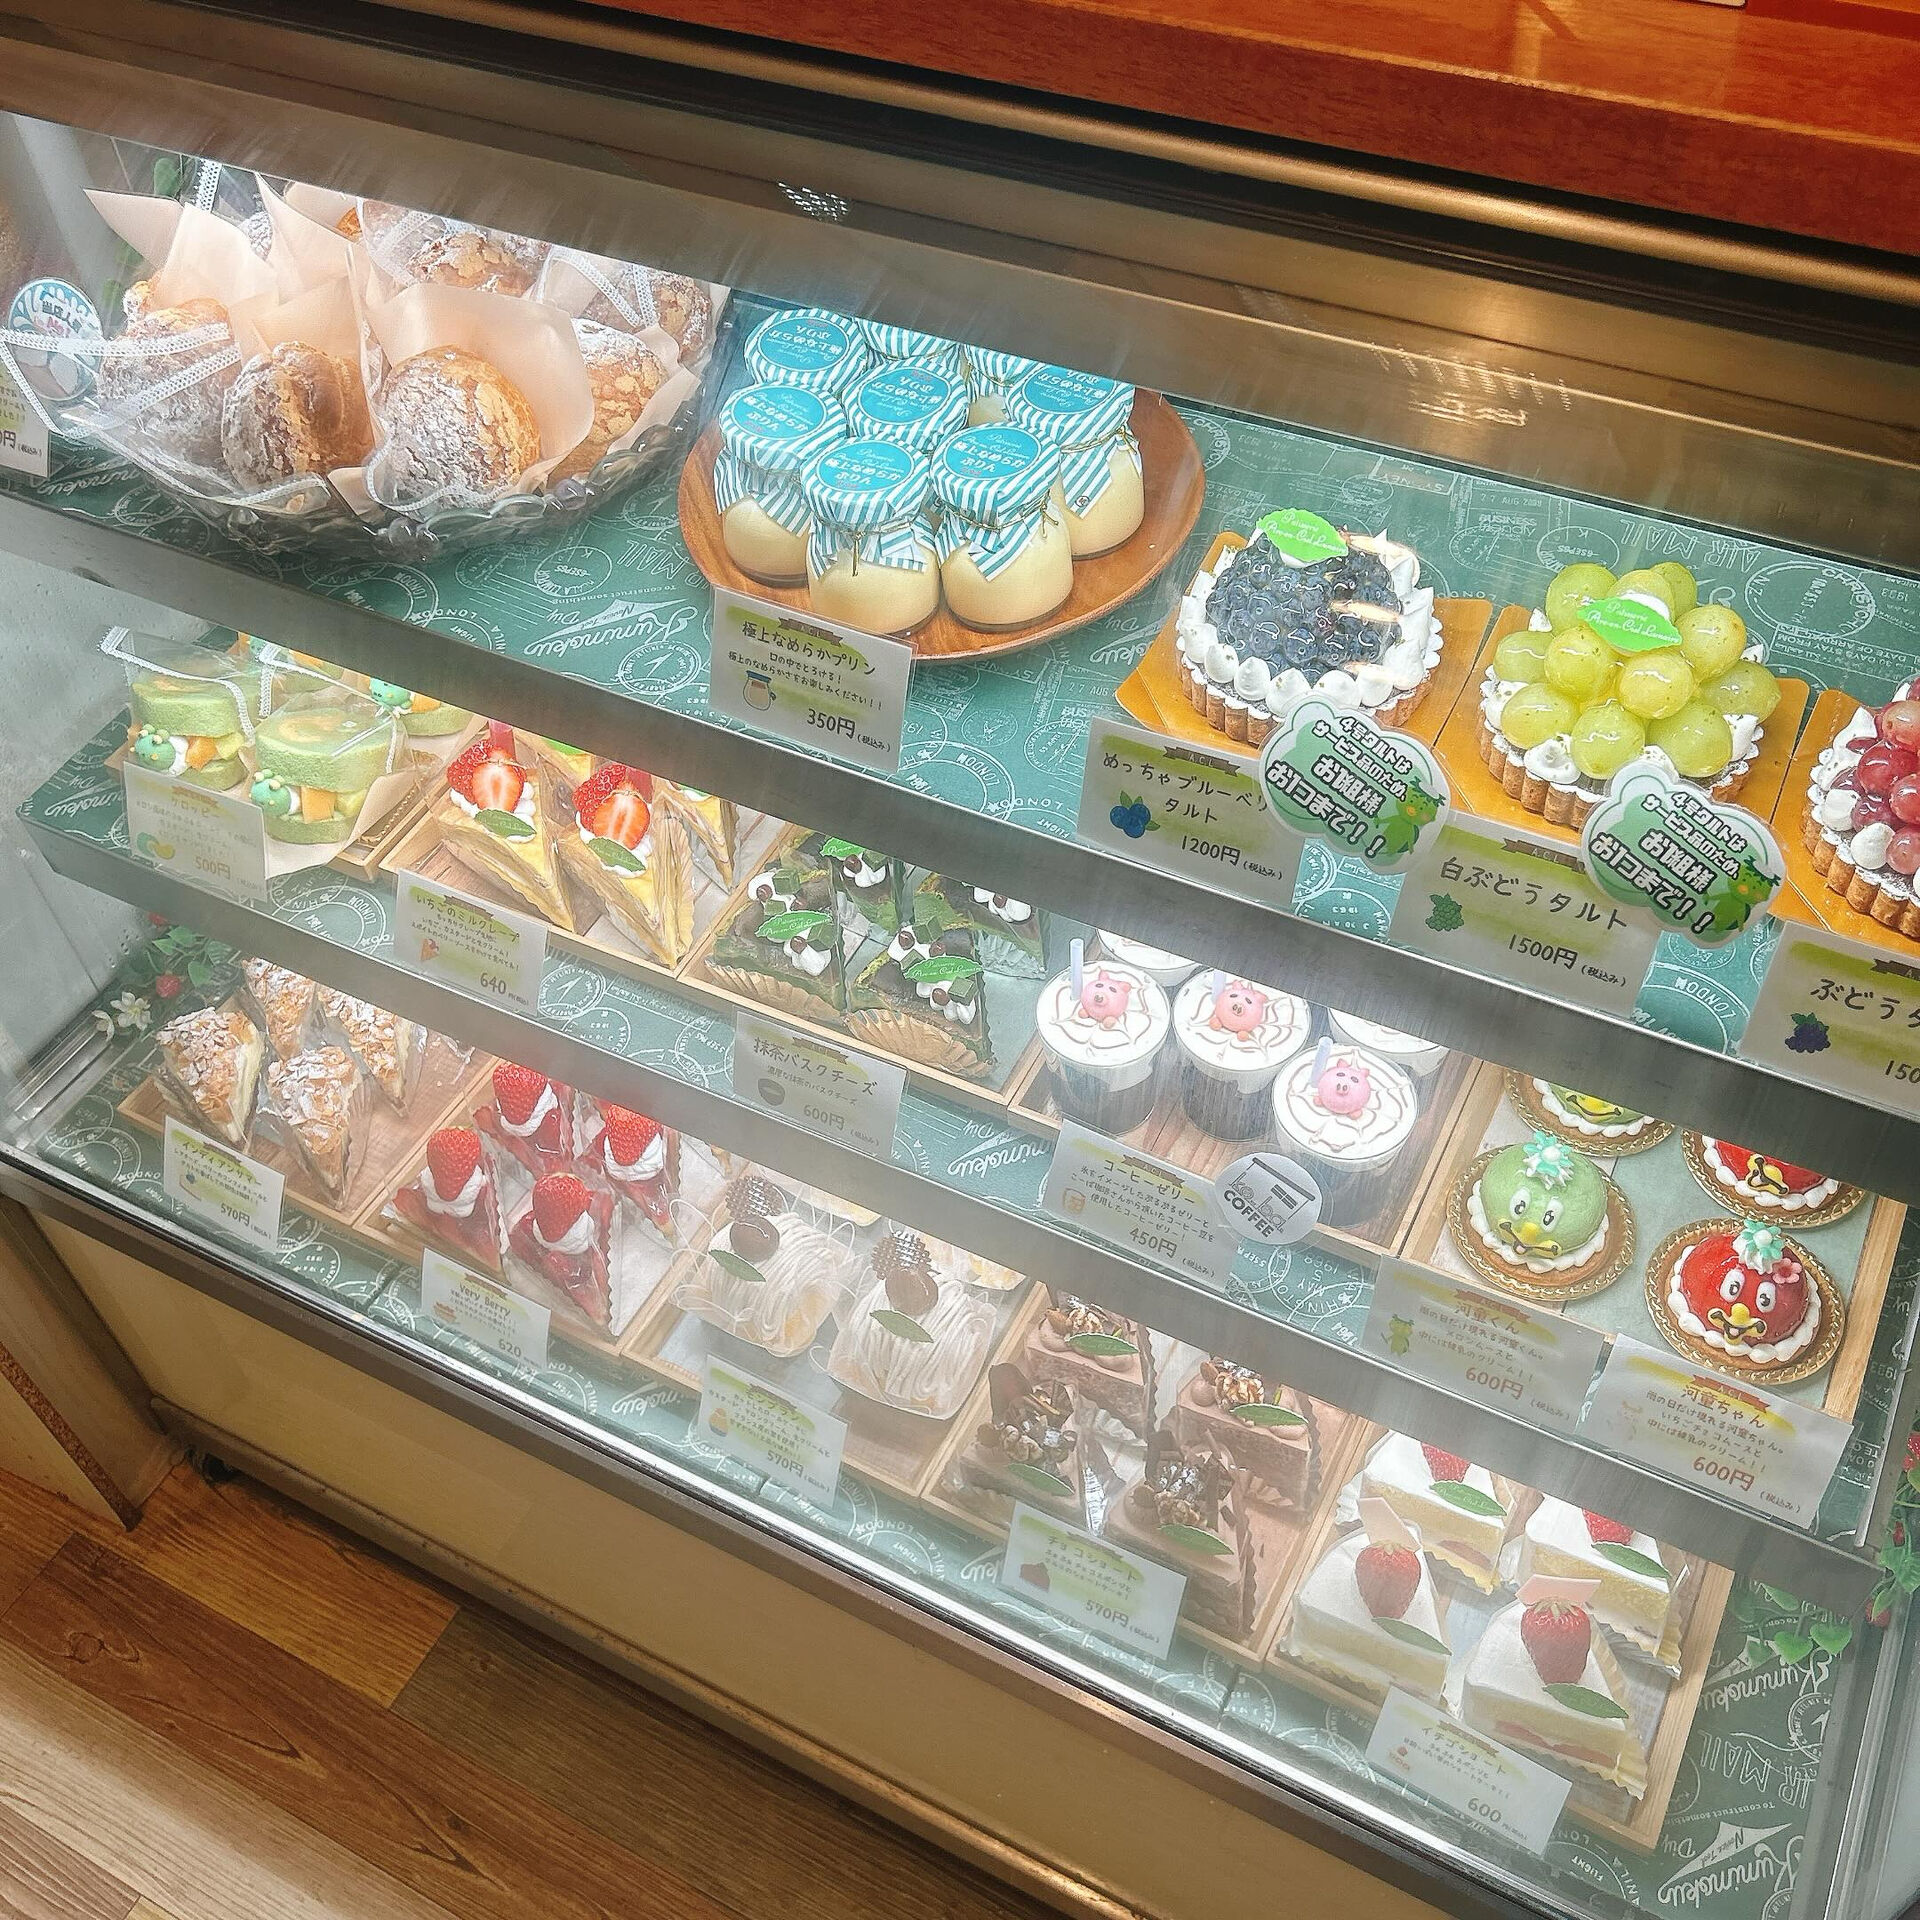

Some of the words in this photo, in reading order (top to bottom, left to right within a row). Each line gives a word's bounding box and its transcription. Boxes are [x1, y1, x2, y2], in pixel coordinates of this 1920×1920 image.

[1620, 519, 1698, 560] MAIL
[741, 620, 876, 676] 極上なめらかプリン
[769, 651, 843, 684] 口の中でとろける！
[806, 708, 856, 739] 350円
[1312, 719, 1408, 802] サービス品のため、
[1339, 716, 1413, 775] 4号タルトは
[1165, 797, 1218, 824] タルト
[1672, 792, 1748, 853] 4号タルトは
[1182, 835, 1241, 866] 1200円
[1641, 794, 1740, 880] サービス品のため、
[195, 856, 232, 881] 500円
[1440, 856, 1627, 930] 白ぶどうタルト
[1508, 934, 1578, 970] 1500円
[1581, 965, 1626, 987] （税込み）
[480, 972, 507, 995] 640
[753, 1036, 878, 1096] 抹茶バスクチーズ
[803, 1104, 845, 1131] 600円
[1103, 1159, 1196, 1205] コーヒーゼリー
[221, 1202, 250, 1227] 570円
[1223, 1189, 1275, 1238] COFFEE
[1129, 1226, 1178, 1259] 450円
[460, 1284, 481, 1301] Very
[485, 1297, 511, 1317] Berry
[1454, 1301, 1521, 1336] 河童くん
[499, 1339, 521, 1358] 620
[1465, 1367, 1524, 1400] 600円
[1682, 1384, 1766, 1429] 河童ちゃん
[767, 1451, 804, 1478] 570円
[1693, 1457, 1755, 1492] 600円
[1048, 1536, 1136, 1581] チョコショート
[1086, 1600, 1129, 1628] 570円
[1422, 1727, 1506, 1775] イチゴショート
[1467, 1798, 1501, 1823] 600
